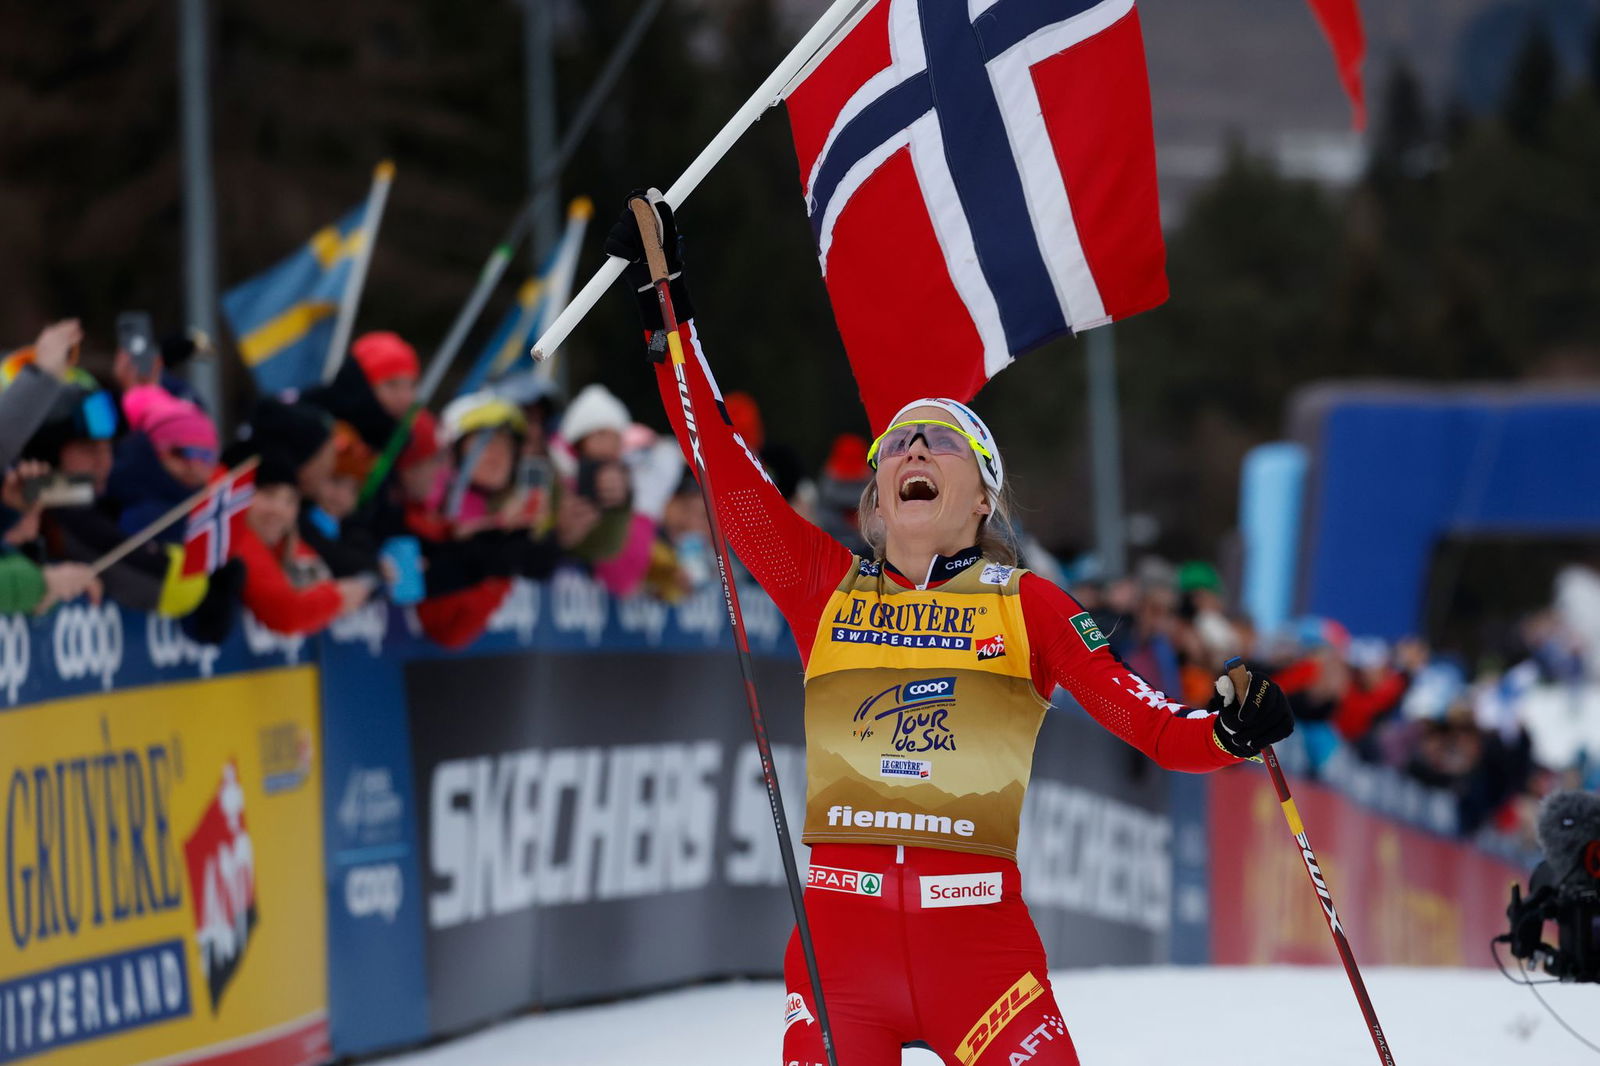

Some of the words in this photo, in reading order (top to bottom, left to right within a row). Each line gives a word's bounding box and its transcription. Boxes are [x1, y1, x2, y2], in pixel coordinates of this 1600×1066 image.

[832, 597, 867, 626] LE
[836, 629, 965, 648] SWITZERLAND
[977, 643, 1006, 658] AOP
[909, 681, 949, 695] coop
[1252, 679, 1271, 709] johaug
[895, 735, 916, 752] de
[882, 760, 890, 769] LE
[827, 805, 976, 838] fiemme
[429, 738, 724, 930] SKECHERS
[808, 869, 857, 889] SPAR
[929, 881, 996, 900] Scandic
[966, 986, 1032, 1056] DHL
